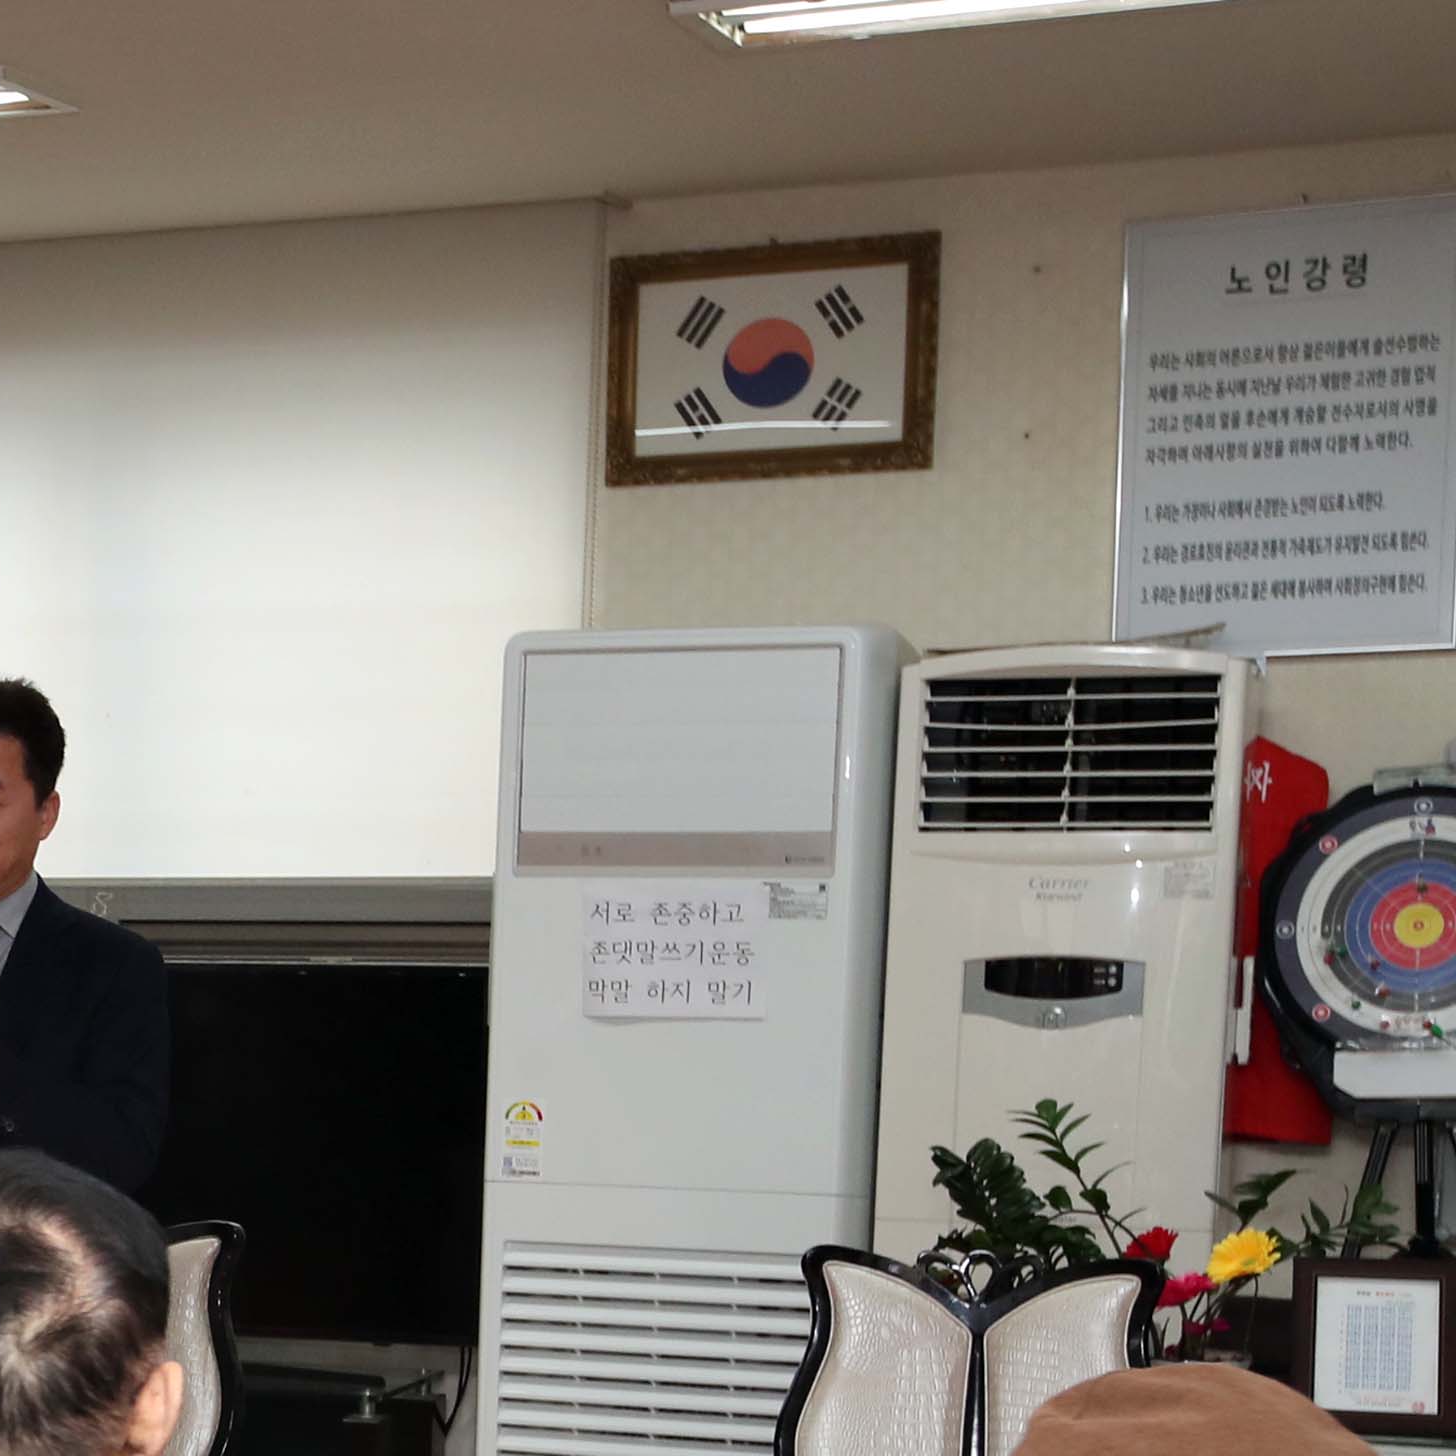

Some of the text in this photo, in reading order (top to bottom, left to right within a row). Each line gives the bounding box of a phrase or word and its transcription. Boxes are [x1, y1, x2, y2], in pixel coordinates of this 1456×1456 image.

[1226, 252, 1369, 294] 노인강령
[590, 901, 745, 927] 서로 존중하고
[591, 940, 755, 967] 존댓말쓰기운동
[588, 979, 752, 1006] 막말 하지 말기
